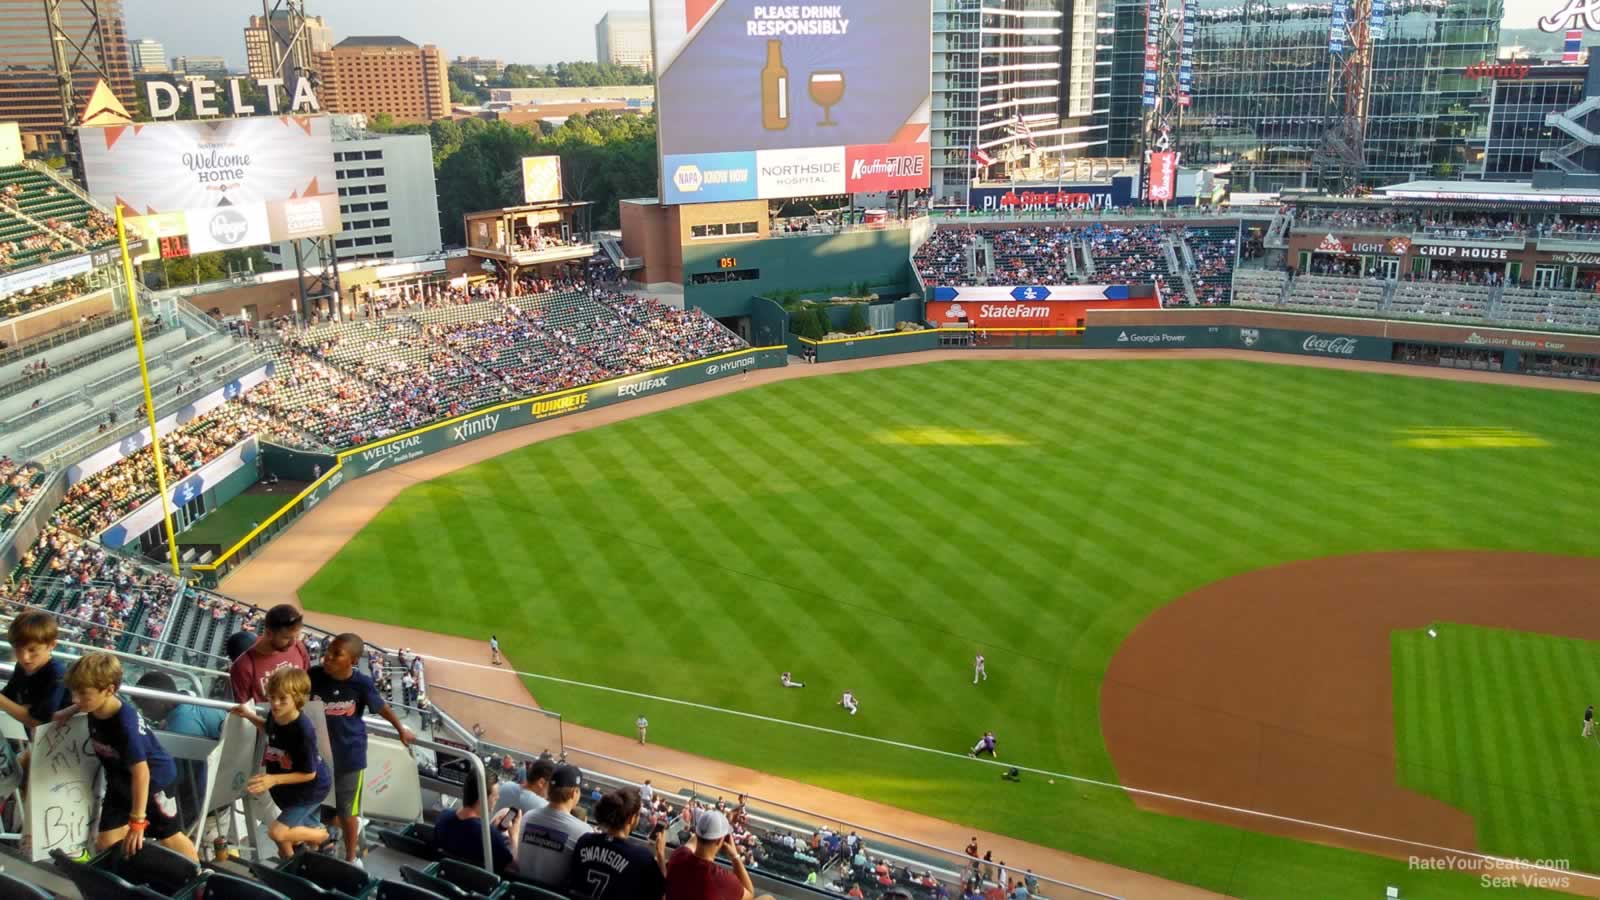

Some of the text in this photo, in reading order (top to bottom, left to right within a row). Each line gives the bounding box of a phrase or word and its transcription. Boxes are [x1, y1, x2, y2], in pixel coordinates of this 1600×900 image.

[753, 5, 842, 19] PLEASE DRINK
[746, 19, 849, 36] RESPONSIBLY
[146, 76, 321, 118] DELTA
[182, 150, 251, 171] Welcome
[887, 155, 925, 177] TIRE
[761, 162, 841, 177] NORTHSIDE
[678, 172, 699, 185] NAPA
[776, 177, 827, 186] HOSPITAL
[1352, 242, 1384, 253] LIGHT
[1420, 245, 1508, 259] CHOP HOUSE
[1130, 333, 1186, 343] Georgia Power
[720, 356, 755, 371] HYUNDAI
[617, 375, 670, 397] EQUIFAX
[532, 393, 589, 414] QUIKRETE
[454, 413, 500, 441] xfinity
[580, 845, 630, 873] SWANSON
[586, 868, 610, 897] 7
